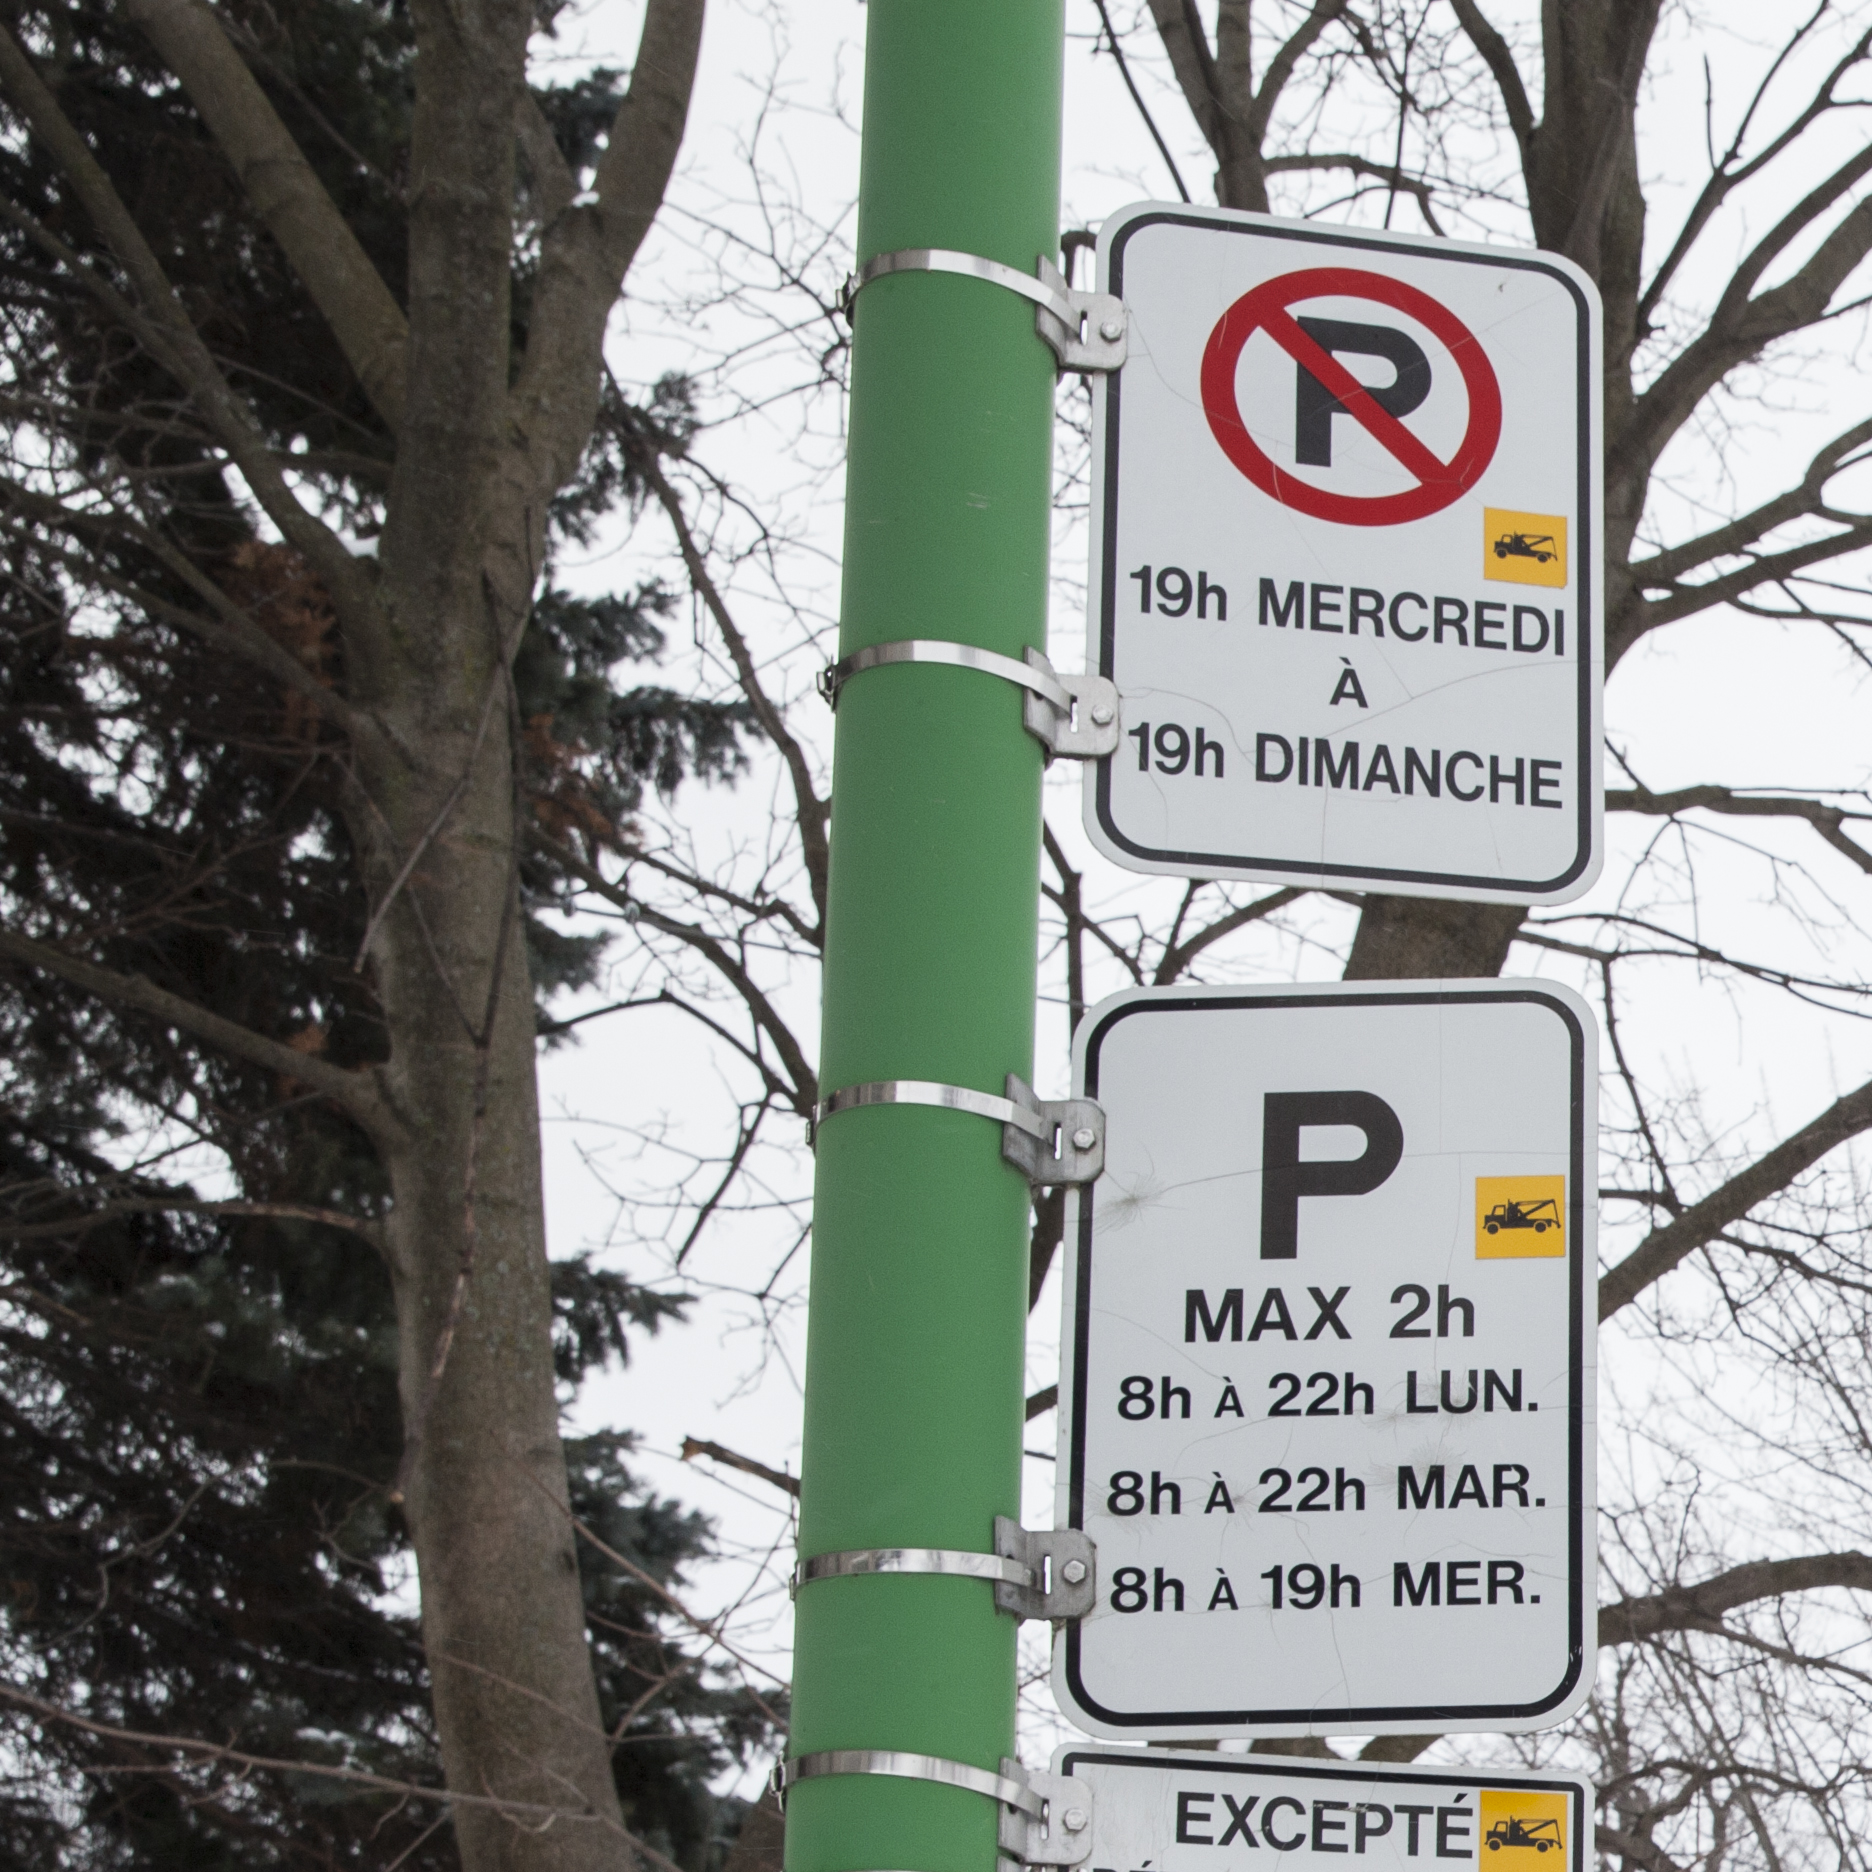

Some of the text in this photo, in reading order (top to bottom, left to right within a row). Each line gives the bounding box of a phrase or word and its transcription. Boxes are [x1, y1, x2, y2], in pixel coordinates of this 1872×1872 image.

[1295, 315, 1433, 468] P
[1129, 564, 1566, 657] 19h MERCREDI
[1329, 656, 1369, 709] À
[1127, 721, 1563, 809] 19h DIMANCHE
[1259, 1089, 1405, 1260] P
[1183, 1283, 1476, 1343] MAX 2h
[1117, 1367, 1540, 1421] 8h À 22h LUN.
[1106, 1463, 1547, 1517] 8h À 22h MAR.
[1110, 1560, 1542, 1614] 8h À 19h MER.
[1175, 1790, 1475, 1860] EXCEPTÉ
